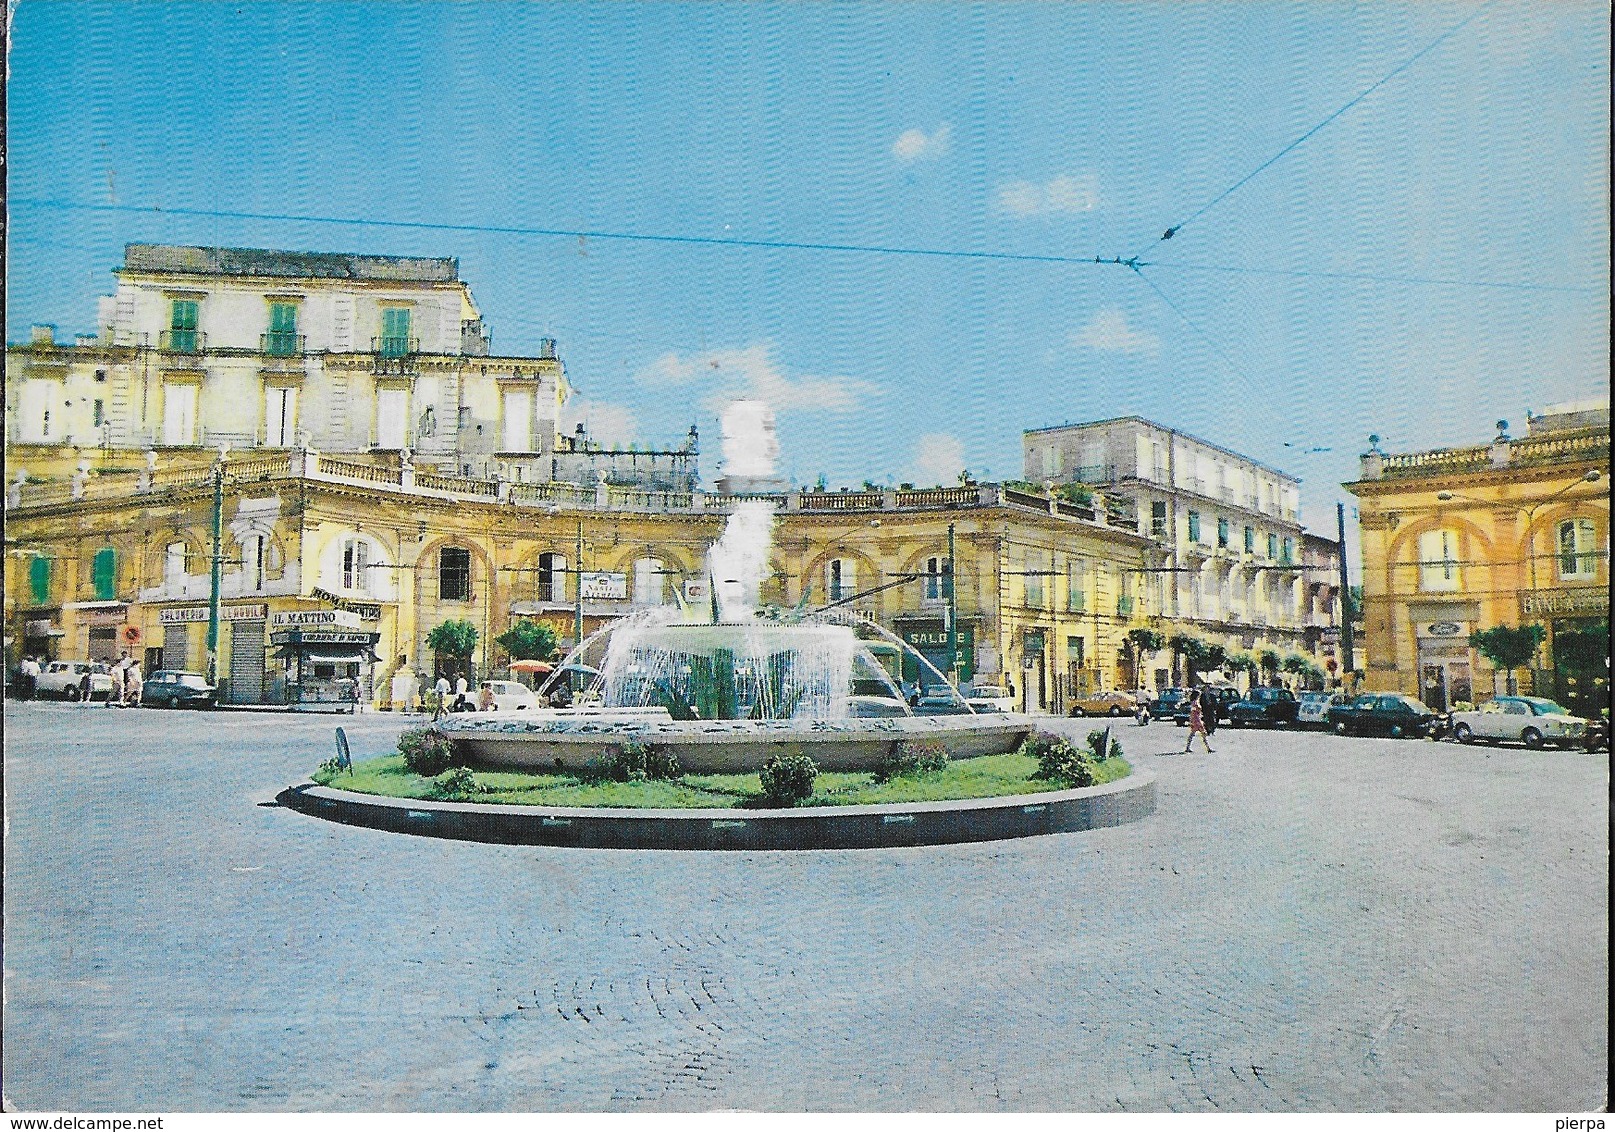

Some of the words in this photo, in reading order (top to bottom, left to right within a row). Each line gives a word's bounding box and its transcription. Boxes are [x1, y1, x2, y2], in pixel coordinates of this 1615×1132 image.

[312, 588, 347, 610] ROMA
[160, 609, 204, 620] SALUMERIA
[274, 614, 285, 624] IL
[287, 612, 336, 624] MATTINO
[910, 632, 965, 643] SALOE
